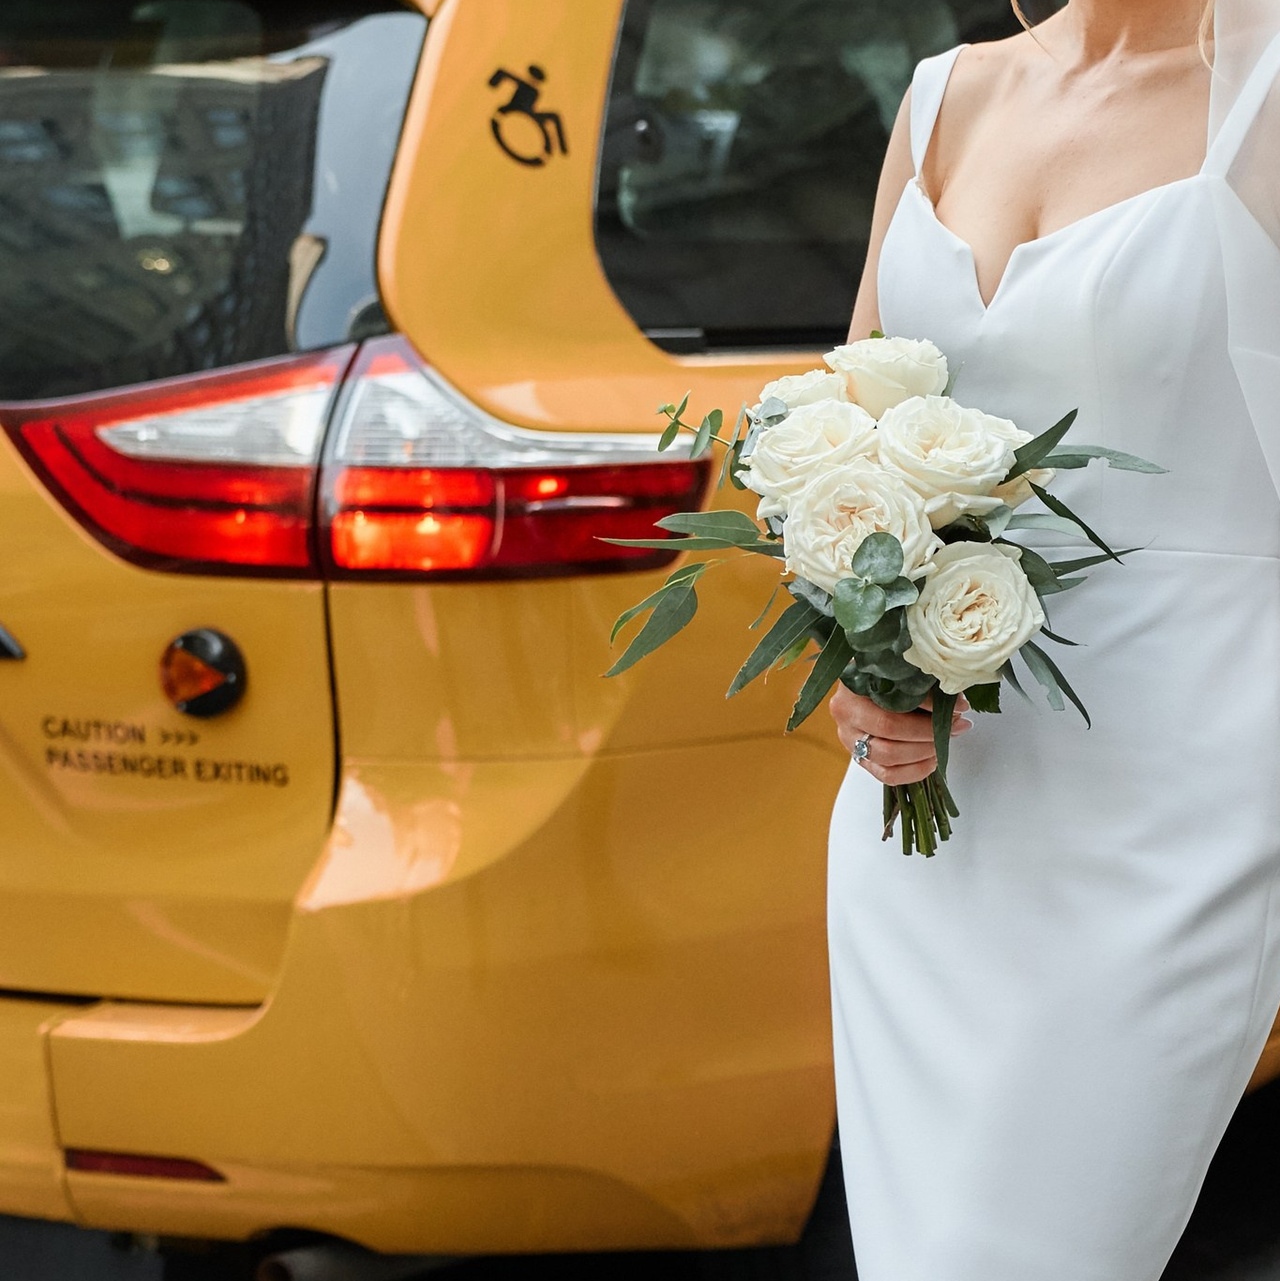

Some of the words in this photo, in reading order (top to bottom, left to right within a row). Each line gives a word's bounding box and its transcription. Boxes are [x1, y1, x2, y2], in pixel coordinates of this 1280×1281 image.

[42, 717, 146, 744] CAUTION
[45, 748, 187, 780] PASSENGER
[195, 758, 289, 788] EXITING
